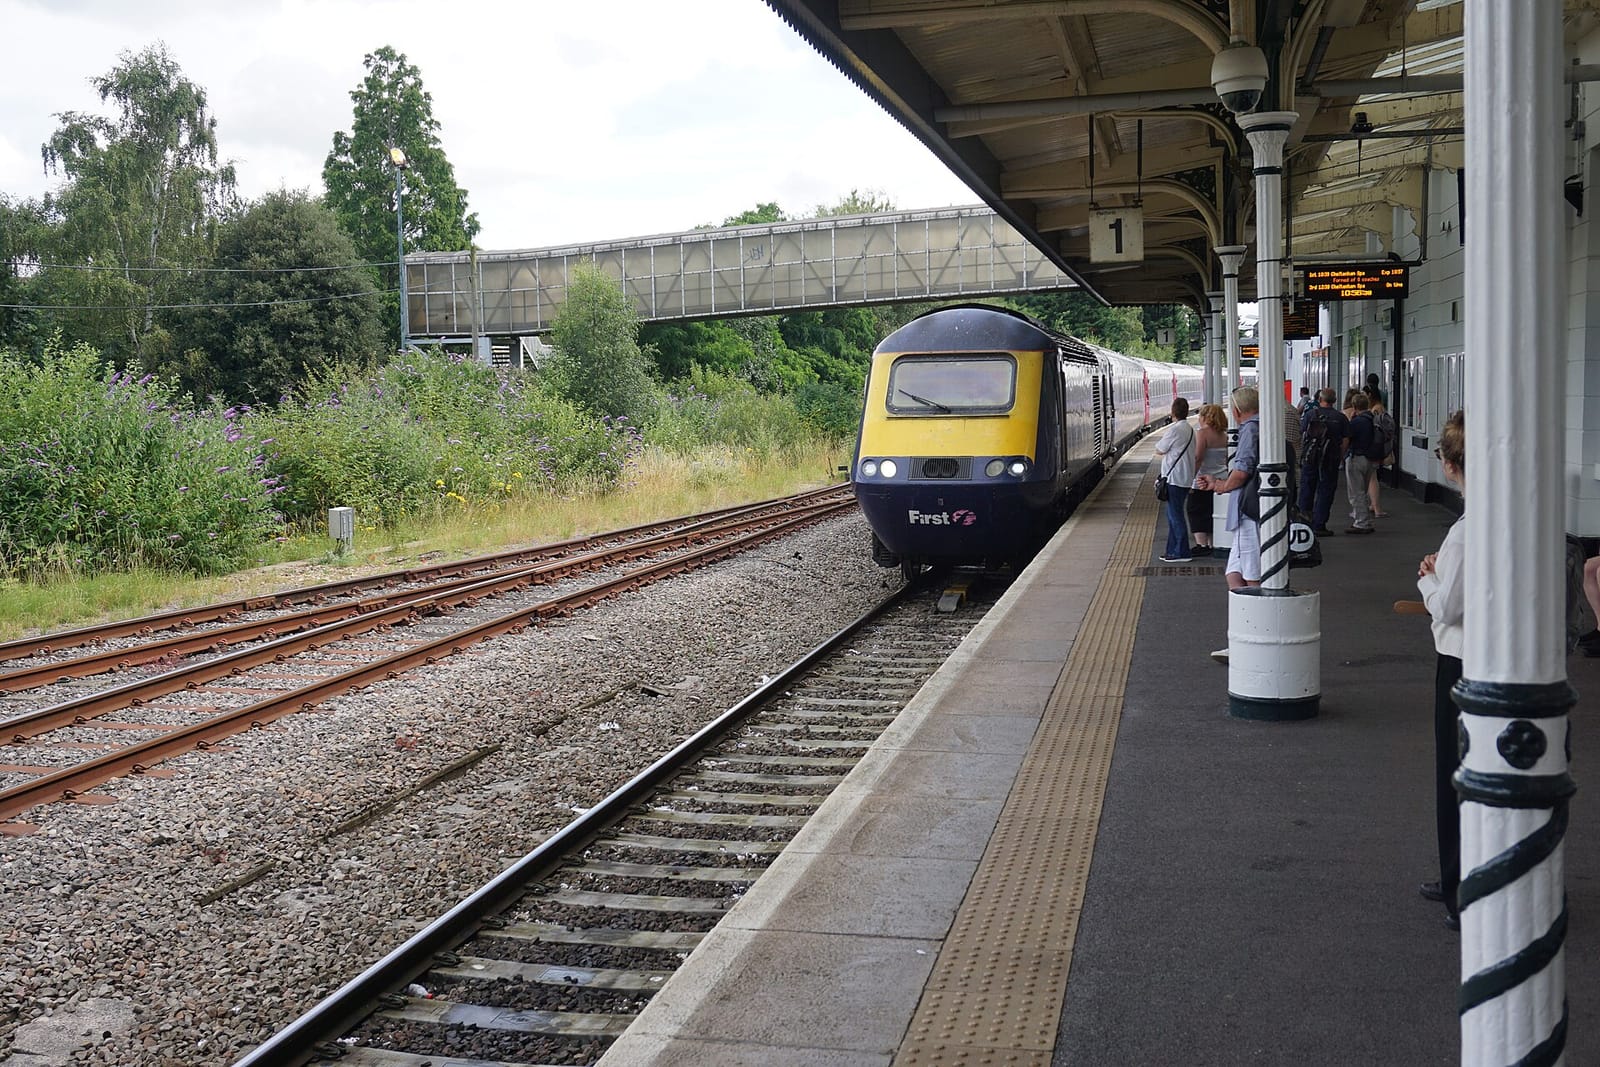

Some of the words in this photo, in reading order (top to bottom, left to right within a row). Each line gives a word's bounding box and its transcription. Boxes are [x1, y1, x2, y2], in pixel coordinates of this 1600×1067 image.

[1109, 218, 1122, 254] 1
[1163, 331, 1168, 342] 1
[908, 509, 950, 525] First
